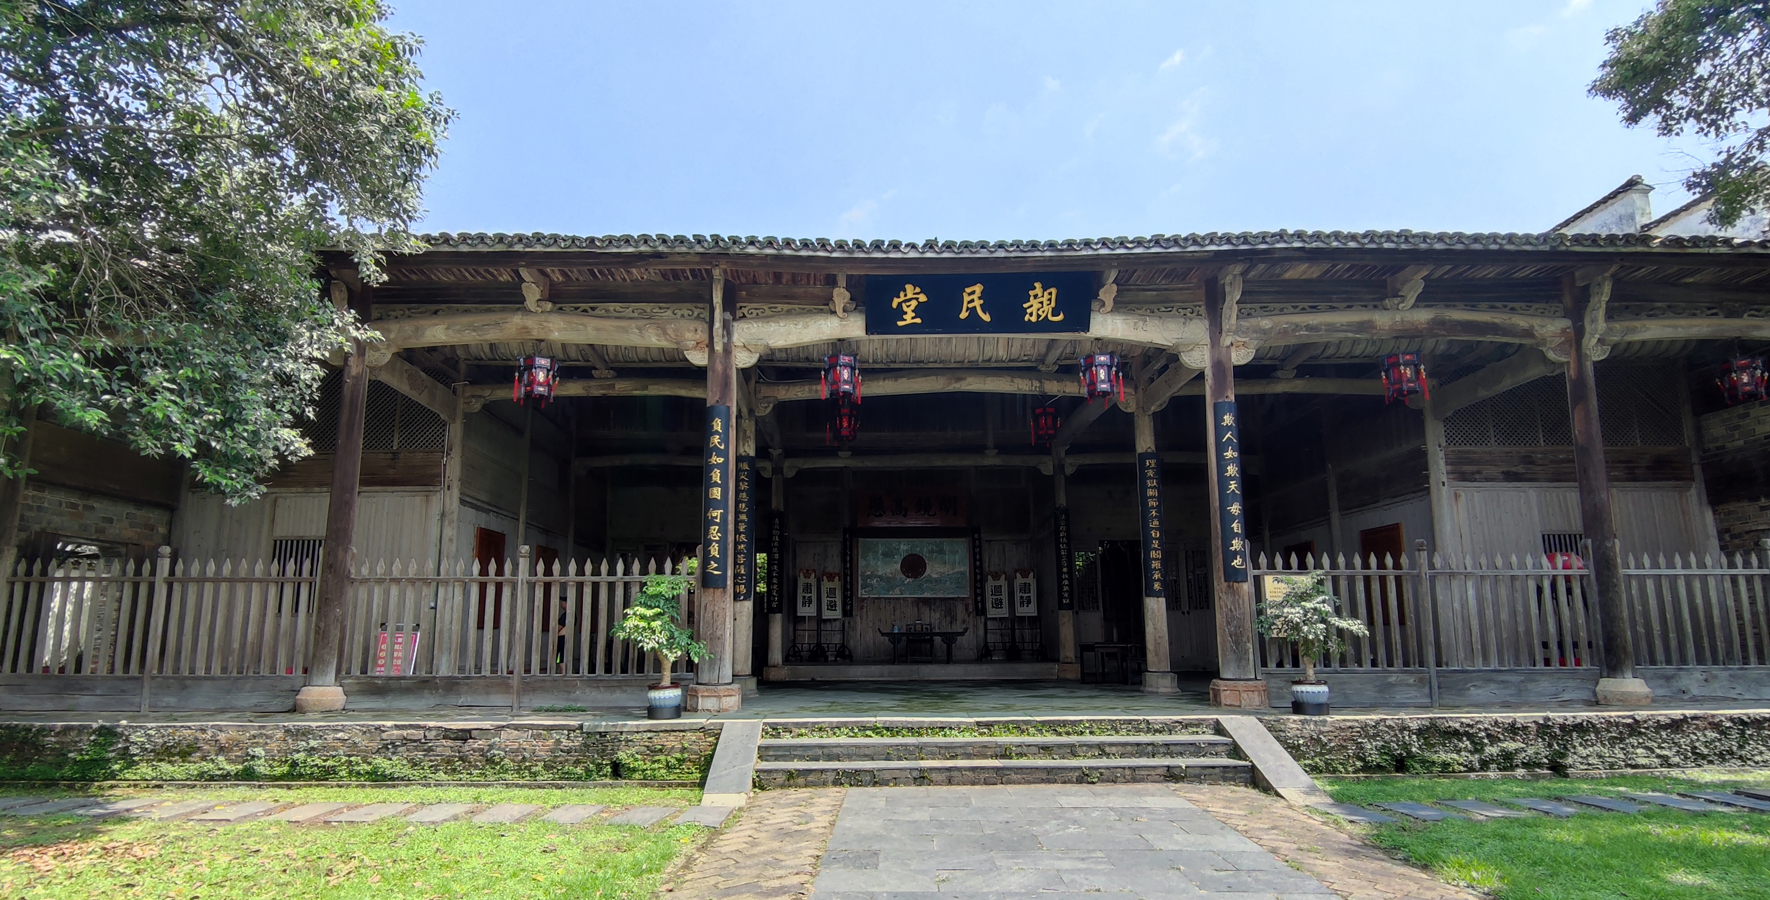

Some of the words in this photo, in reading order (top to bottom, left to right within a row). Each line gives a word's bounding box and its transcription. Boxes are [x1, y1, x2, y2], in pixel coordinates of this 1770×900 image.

[891, 281, 1065, 327] 親民堂
[705, 416, 725, 575] 負民如負國何忍負之
[867, 494, 958, 518] 明鏡高懸
[1221, 413, 1246, 569] 欺人如欺天毋自欺也
[801, 582, 813, 608] 肅靜
[1018, 582, 1032, 608] 肅靜
